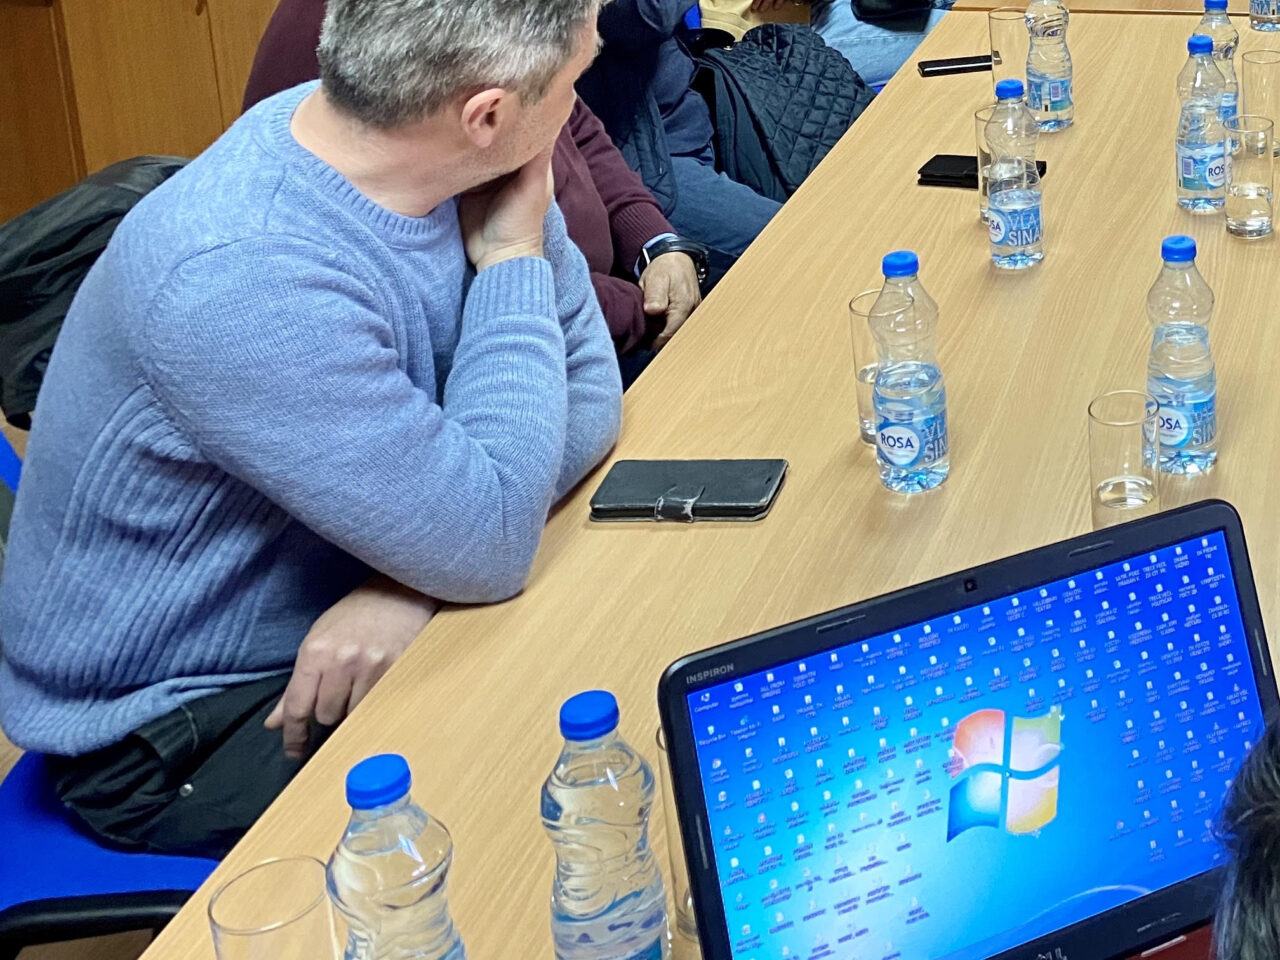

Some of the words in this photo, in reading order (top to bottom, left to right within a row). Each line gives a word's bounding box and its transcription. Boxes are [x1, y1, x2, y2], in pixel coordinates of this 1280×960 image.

[1208, 164, 1226, 177] ROS
[881, 432, 914, 449] ROSA
[686, 663, 735, 684] INSPIRON
